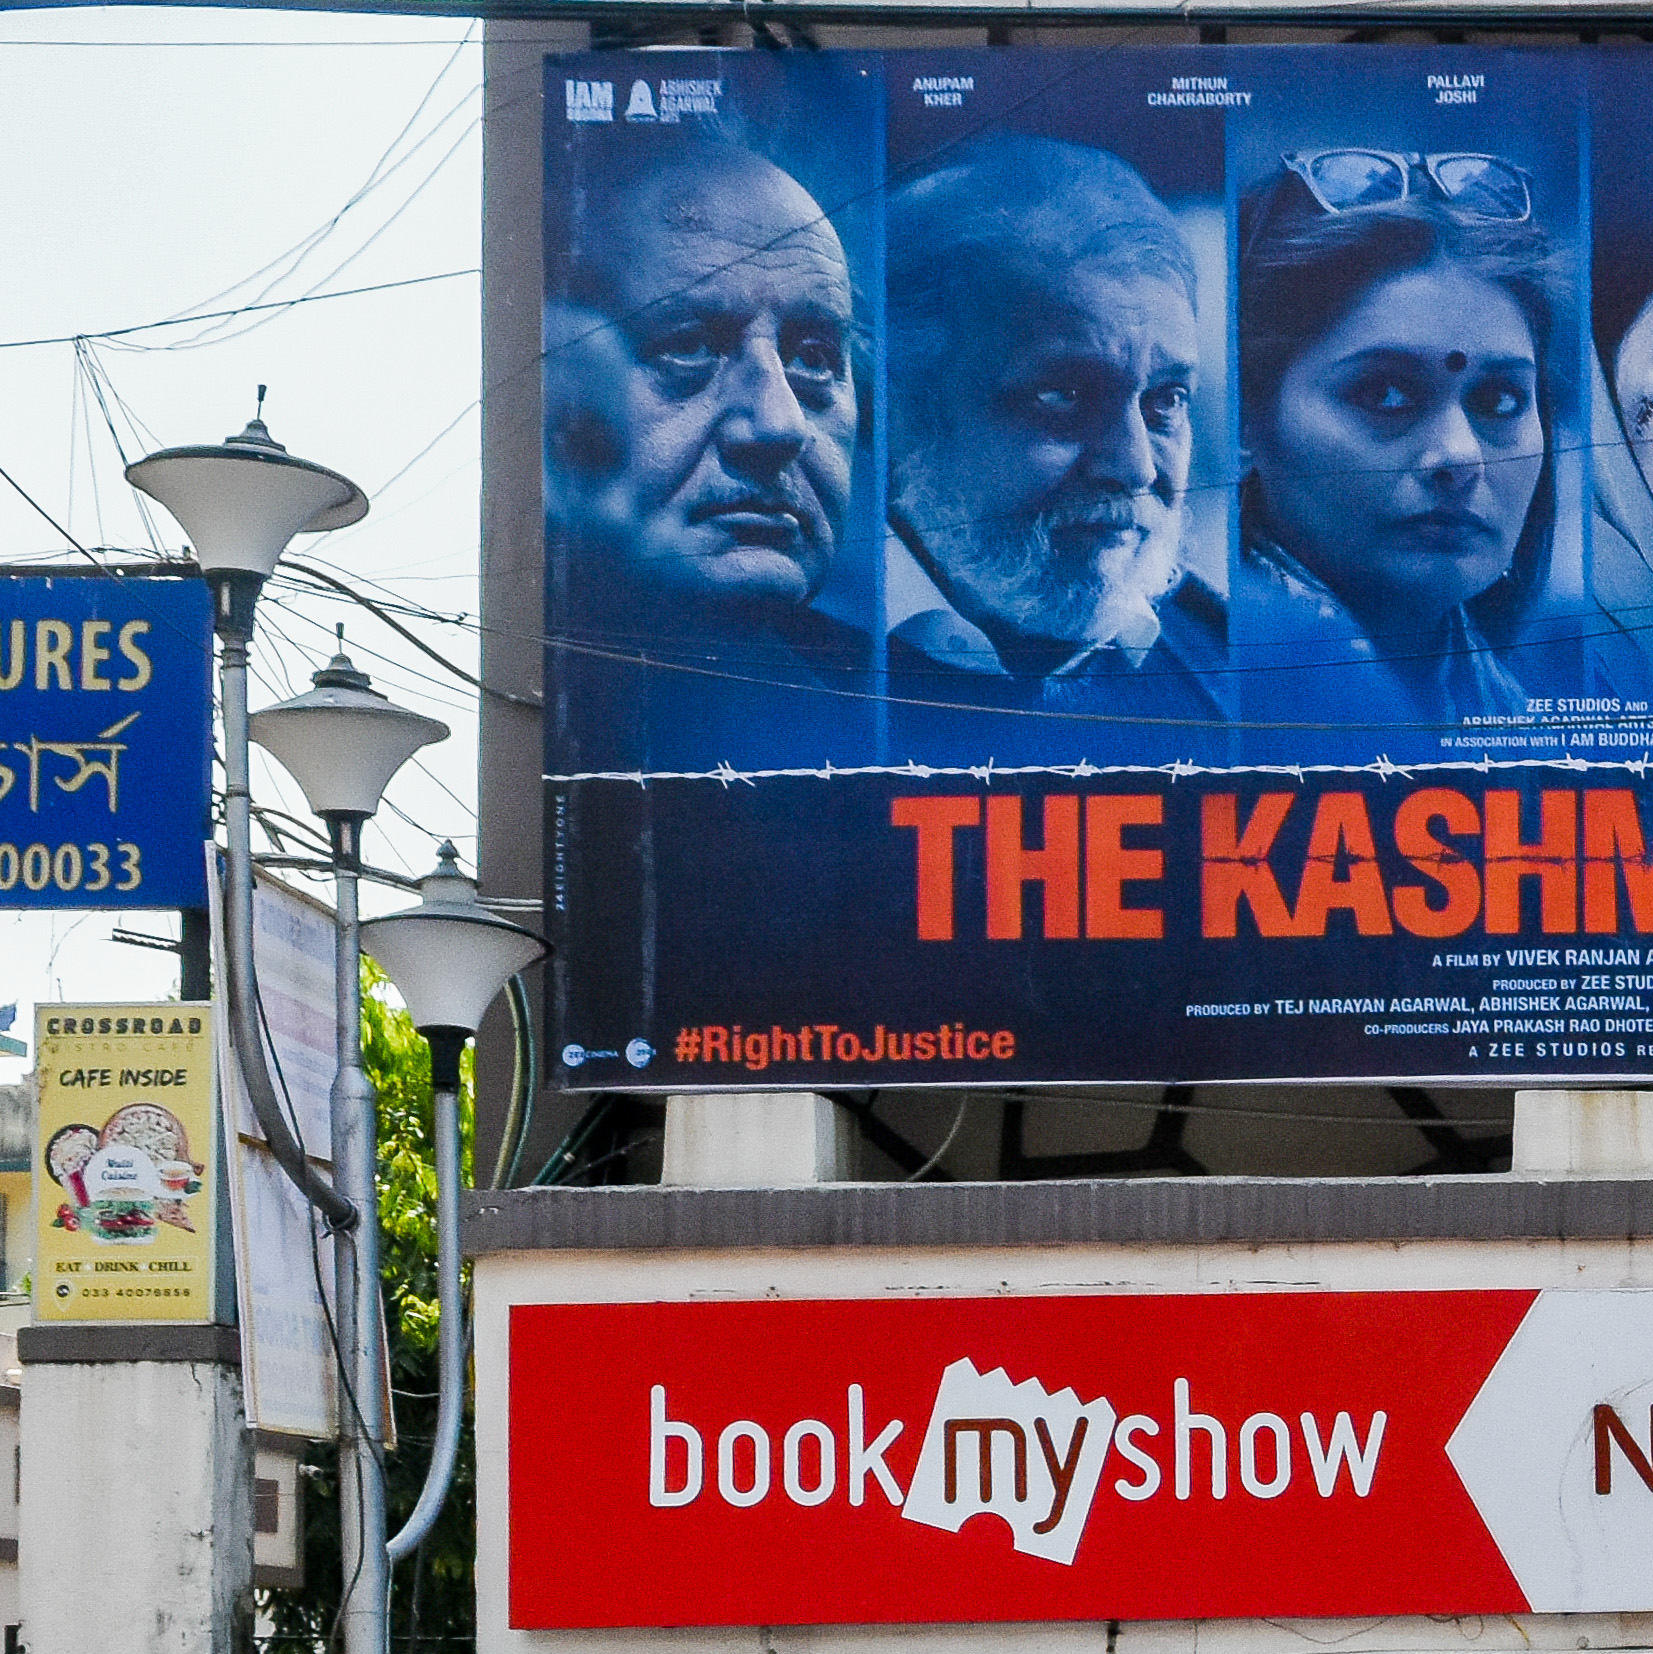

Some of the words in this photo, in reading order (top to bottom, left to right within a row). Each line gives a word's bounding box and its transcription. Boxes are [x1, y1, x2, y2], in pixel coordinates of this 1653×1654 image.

[913, 77, 974, 91] ANUPAM
[1172, 77, 1227, 90] MITHUN
[1428, 75, 1484, 88] PALLAVI
[924, 92, 962, 107] KHER
[1148, 92, 1252, 106] CHAKRABORTY
[1436, 90, 1476, 104] JOSHI
[891, 795, 1163, 940] THE
[1432, 955, 1442, 967] A
[1446, 954, 1479, 967] FILM
[1482, 954, 1501, 967] BY
[1506, 949, 1560, 966] VIVEK
[1565, 949, 1640, 965] RANJAN
[1186, 1003, 1251, 1016] PRODUCED
[1254, 1003, 1270, 1015] BY
[1275, 999, 1304, 1014] TEJ
[1309, 998, 1385, 1014] NARAYAN
[1390, 997, 1475, 1014] AGARWAL,
[1479, 996, 1560, 1011] ABHISHEK
[1565, 996, 1650, 1012] AGARWAL,
[47, 1018, 201, 1035] CROSSROAD
[675, 1023, 1015, 1070] #RightToJustice
[60, 1069, 111, 1088] CAFE
[119, 1069, 187, 1087] INSIDE
[56, 1261, 80, 1272] EAT
[94, 1261, 140, 1272] DRINK
[148, 1261, 193, 1272] CHILL
[649, 1371, 1387, 1540] bookmyshow
